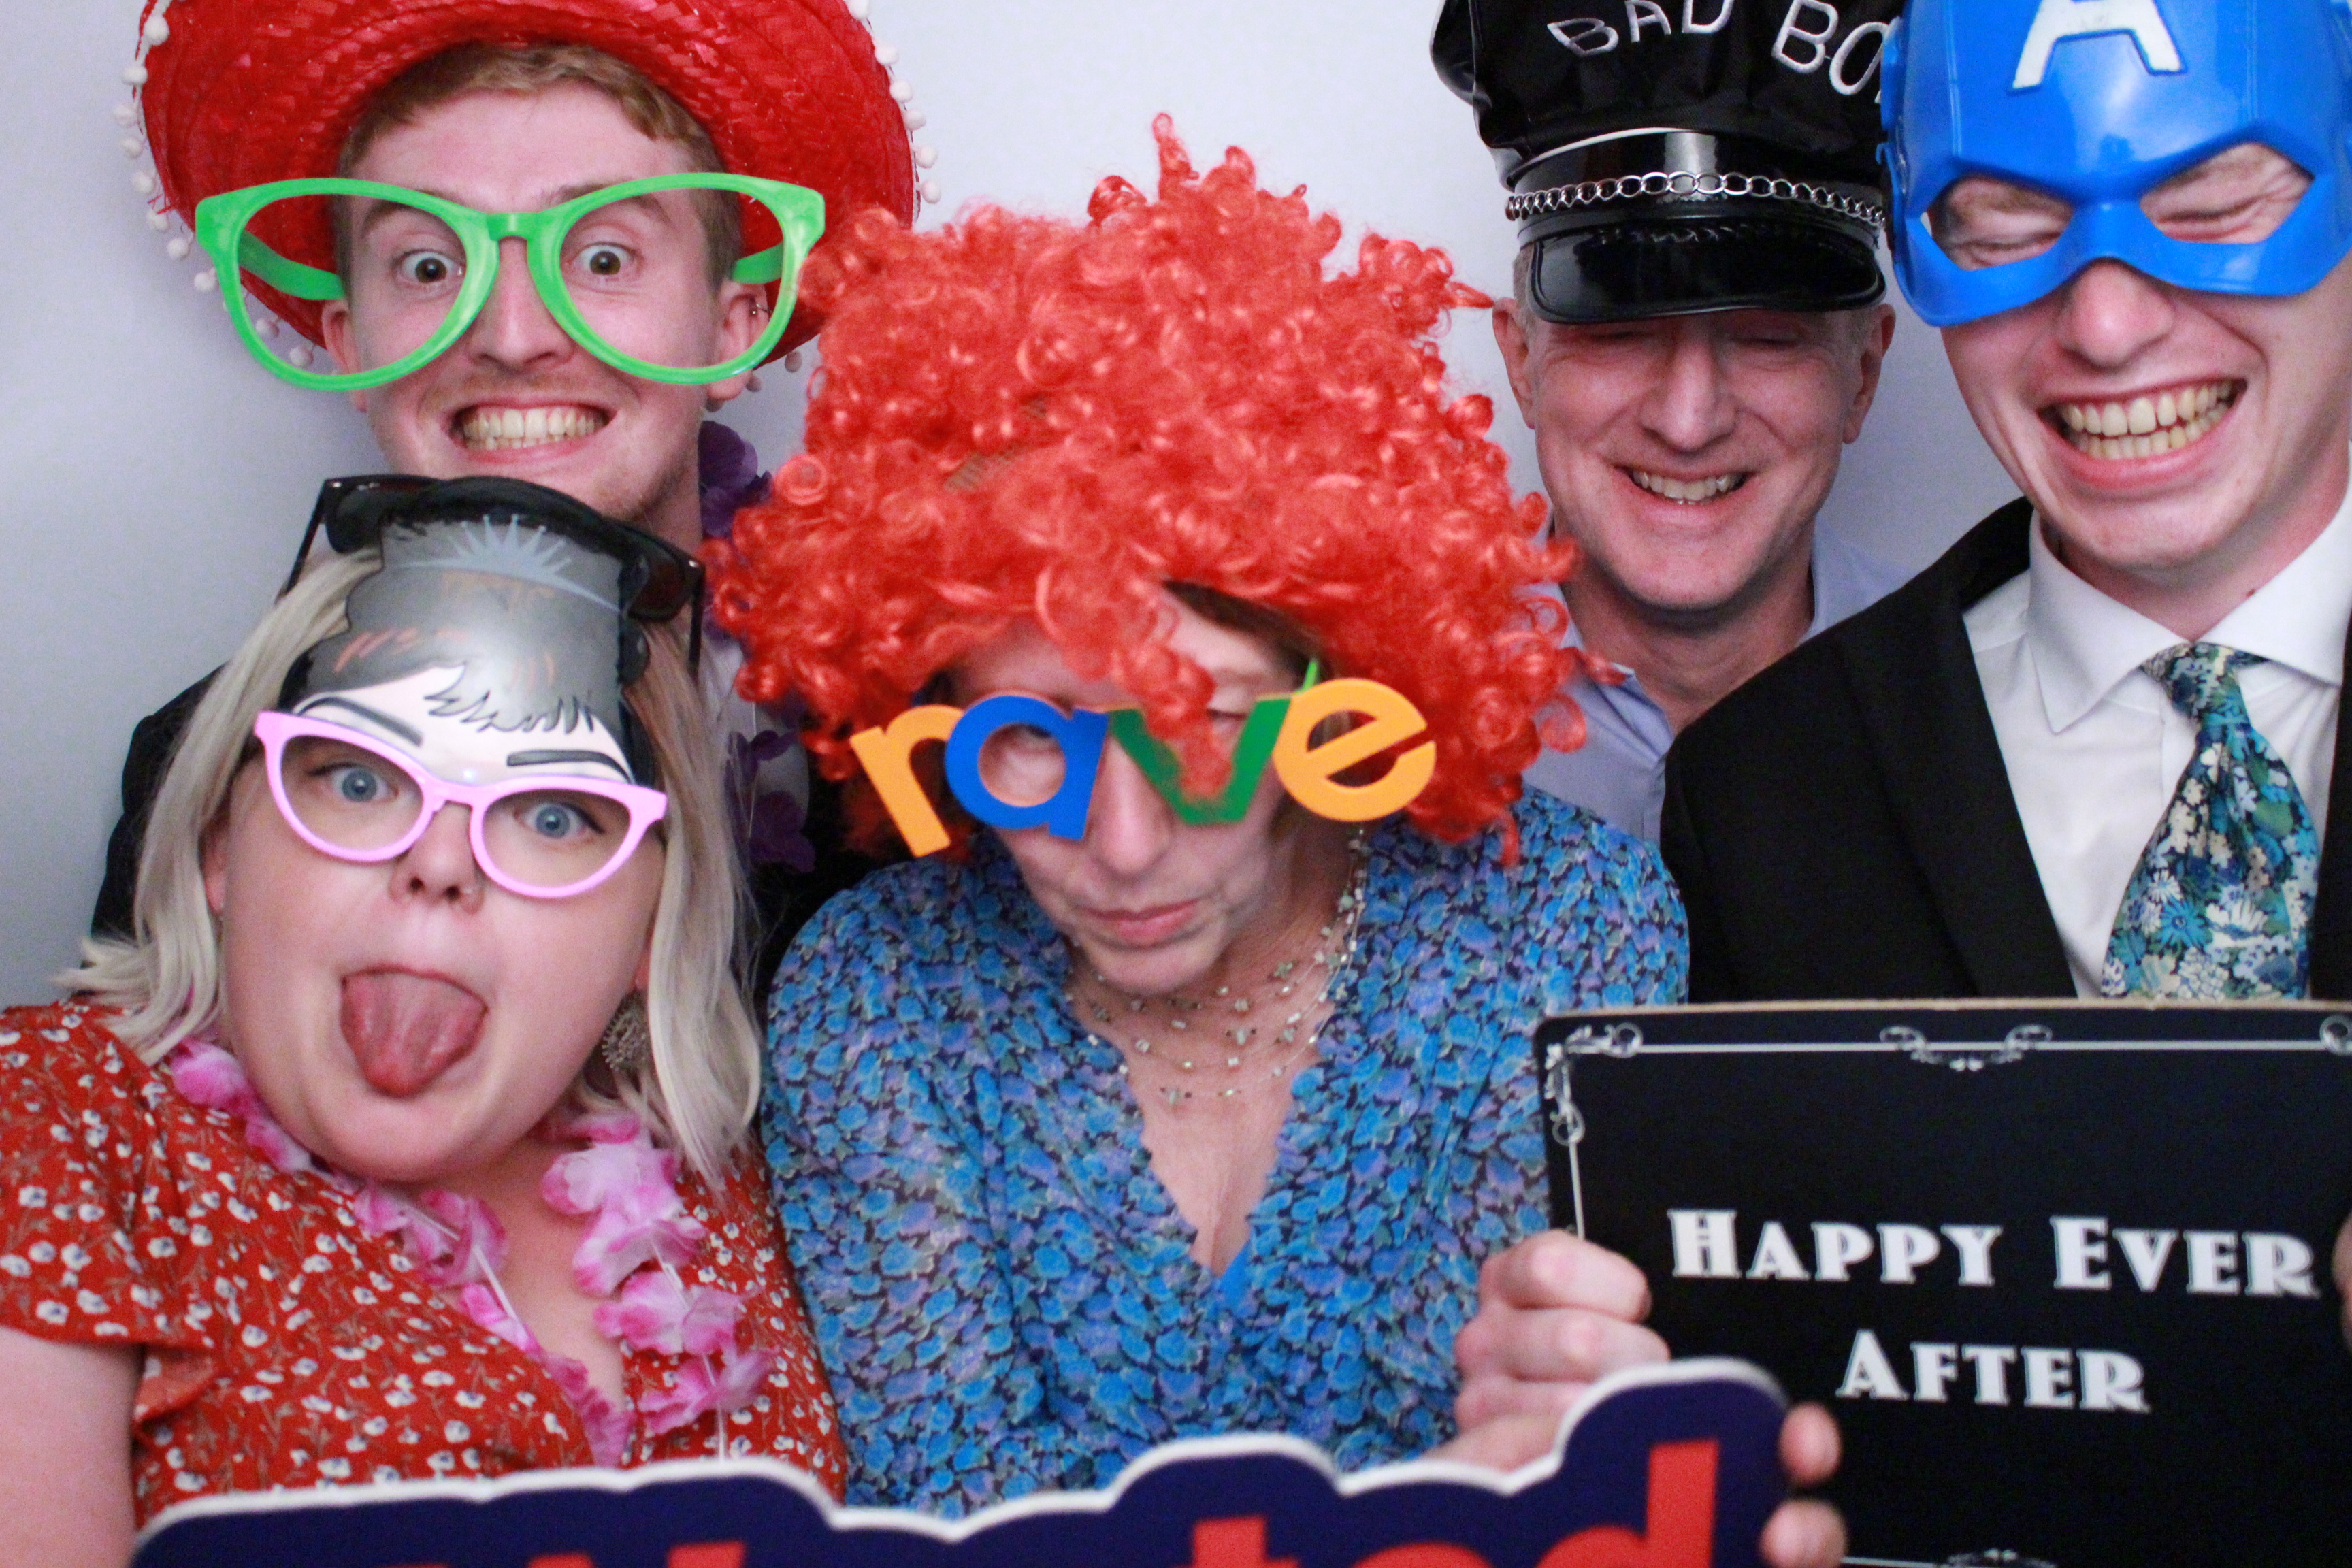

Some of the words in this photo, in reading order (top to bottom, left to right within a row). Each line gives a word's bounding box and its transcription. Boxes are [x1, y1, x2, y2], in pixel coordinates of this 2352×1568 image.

[1772, 0, 1885, 103] BO
[2012, 0, 2183, 91] A
[850, 678, 1437, 858] rave
[1667, 1209, 2003, 1287] HAPPY
[2049, 1215, 2321, 1298] EVER
[1835, 1329, 2151, 1414] AFTER
